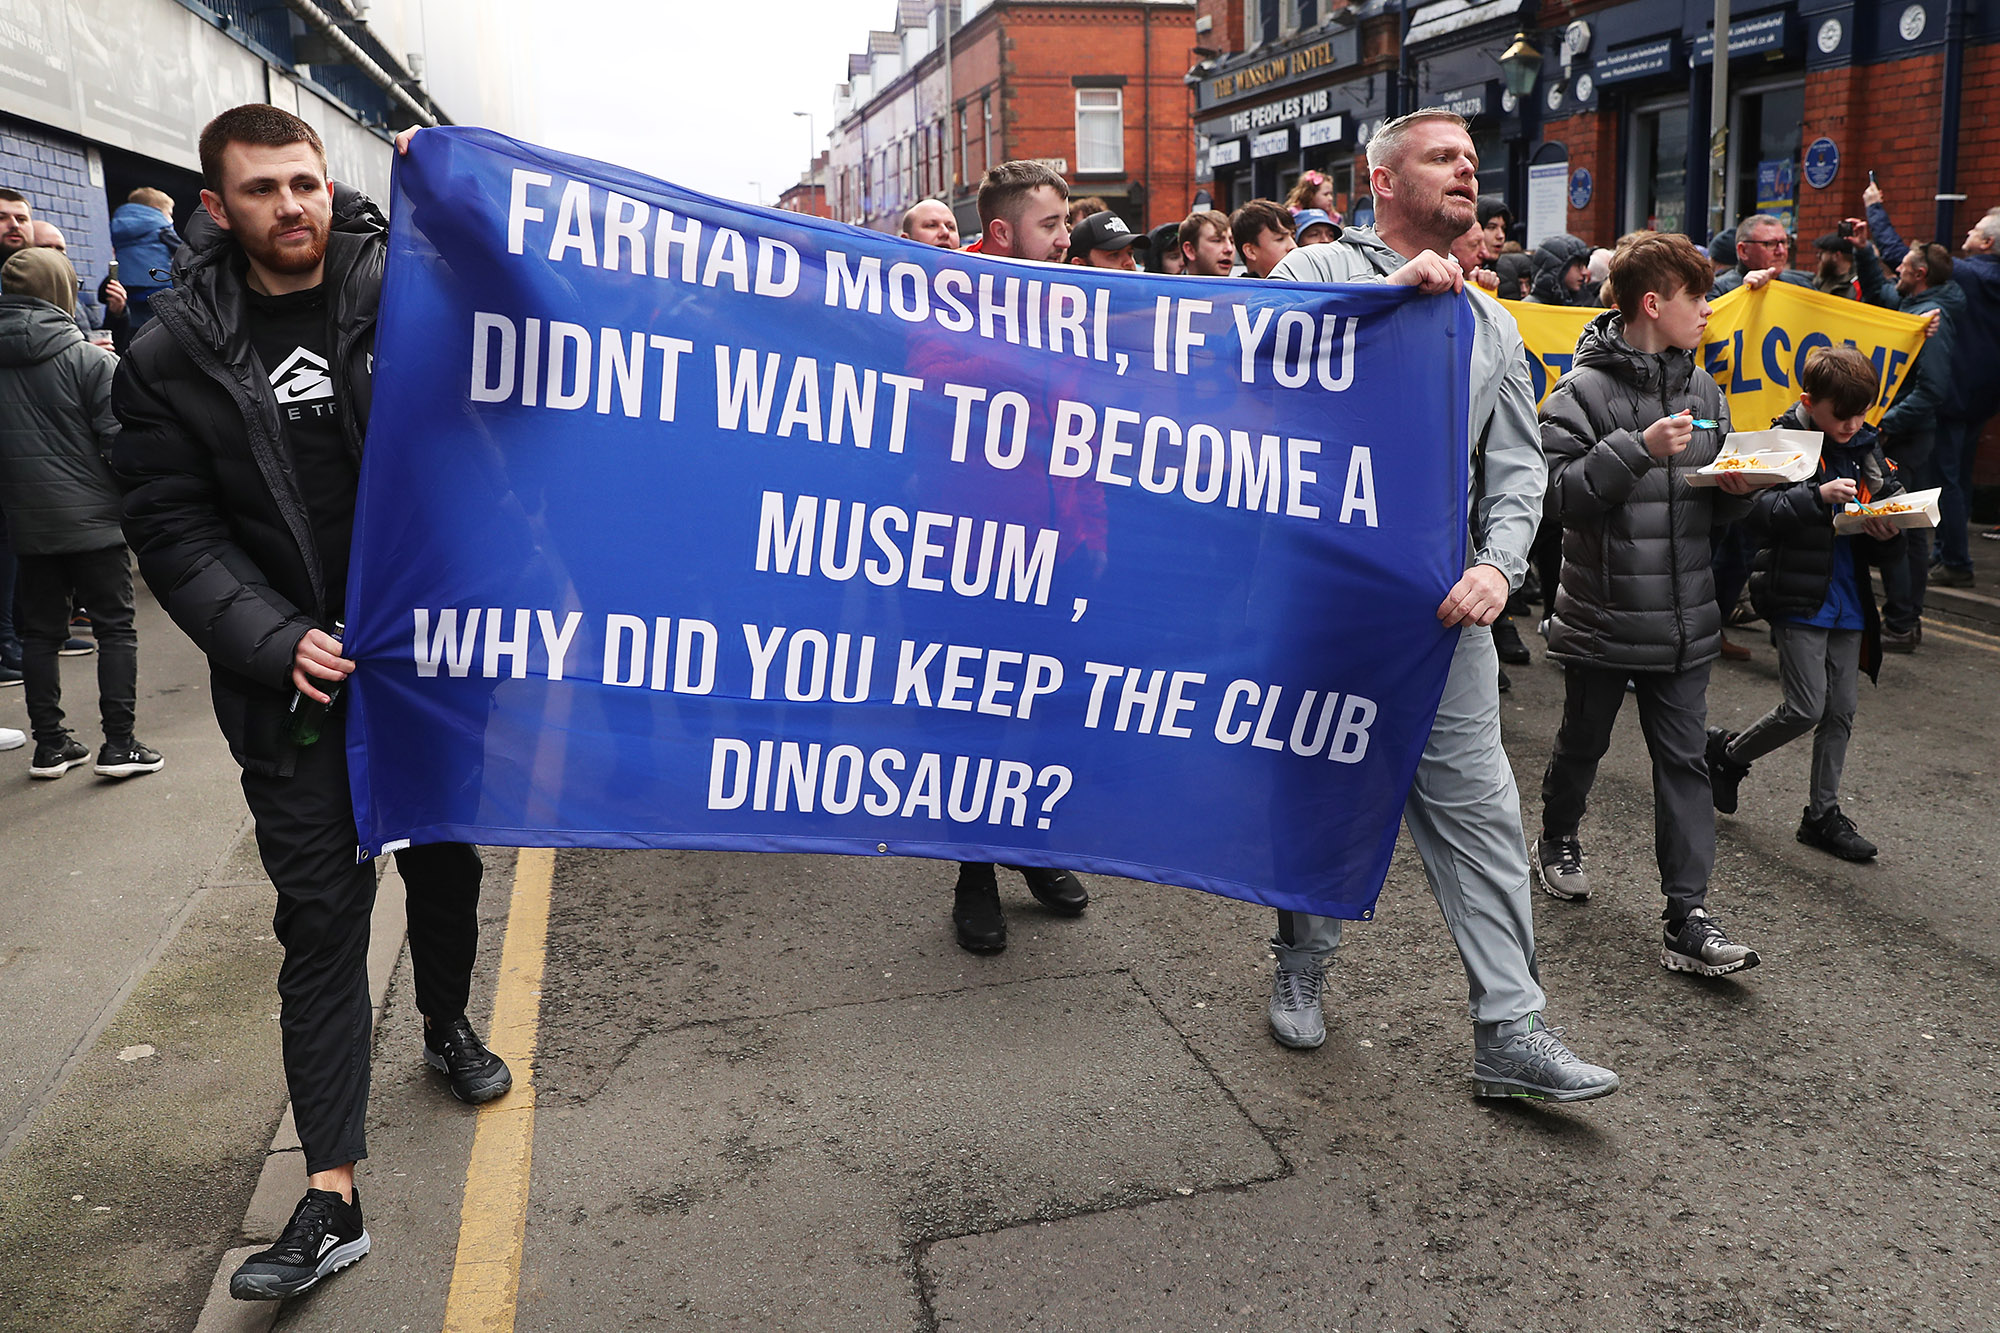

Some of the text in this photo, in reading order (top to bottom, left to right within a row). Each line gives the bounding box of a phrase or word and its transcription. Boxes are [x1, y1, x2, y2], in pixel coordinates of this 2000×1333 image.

[1213, 41, 1335, 99] THE WINSLOW HOTEL
[1230, 90, 1329, 133] THE PEOPLES PUB
[508, 168, 1358, 391] FARHAD MOSHIRI, IF YOU
[1692, 326, 1909, 408] ELCOE
[471, 312, 1378, 527] DIDNT WANT TO BECOME A
[756, 491, 1059, 605] MUSEUM
[414, 608, 1377, 763] WHY DID YOU KEEP THE CLUB
[708, 738, 1072, 829] DINOSAUR?
